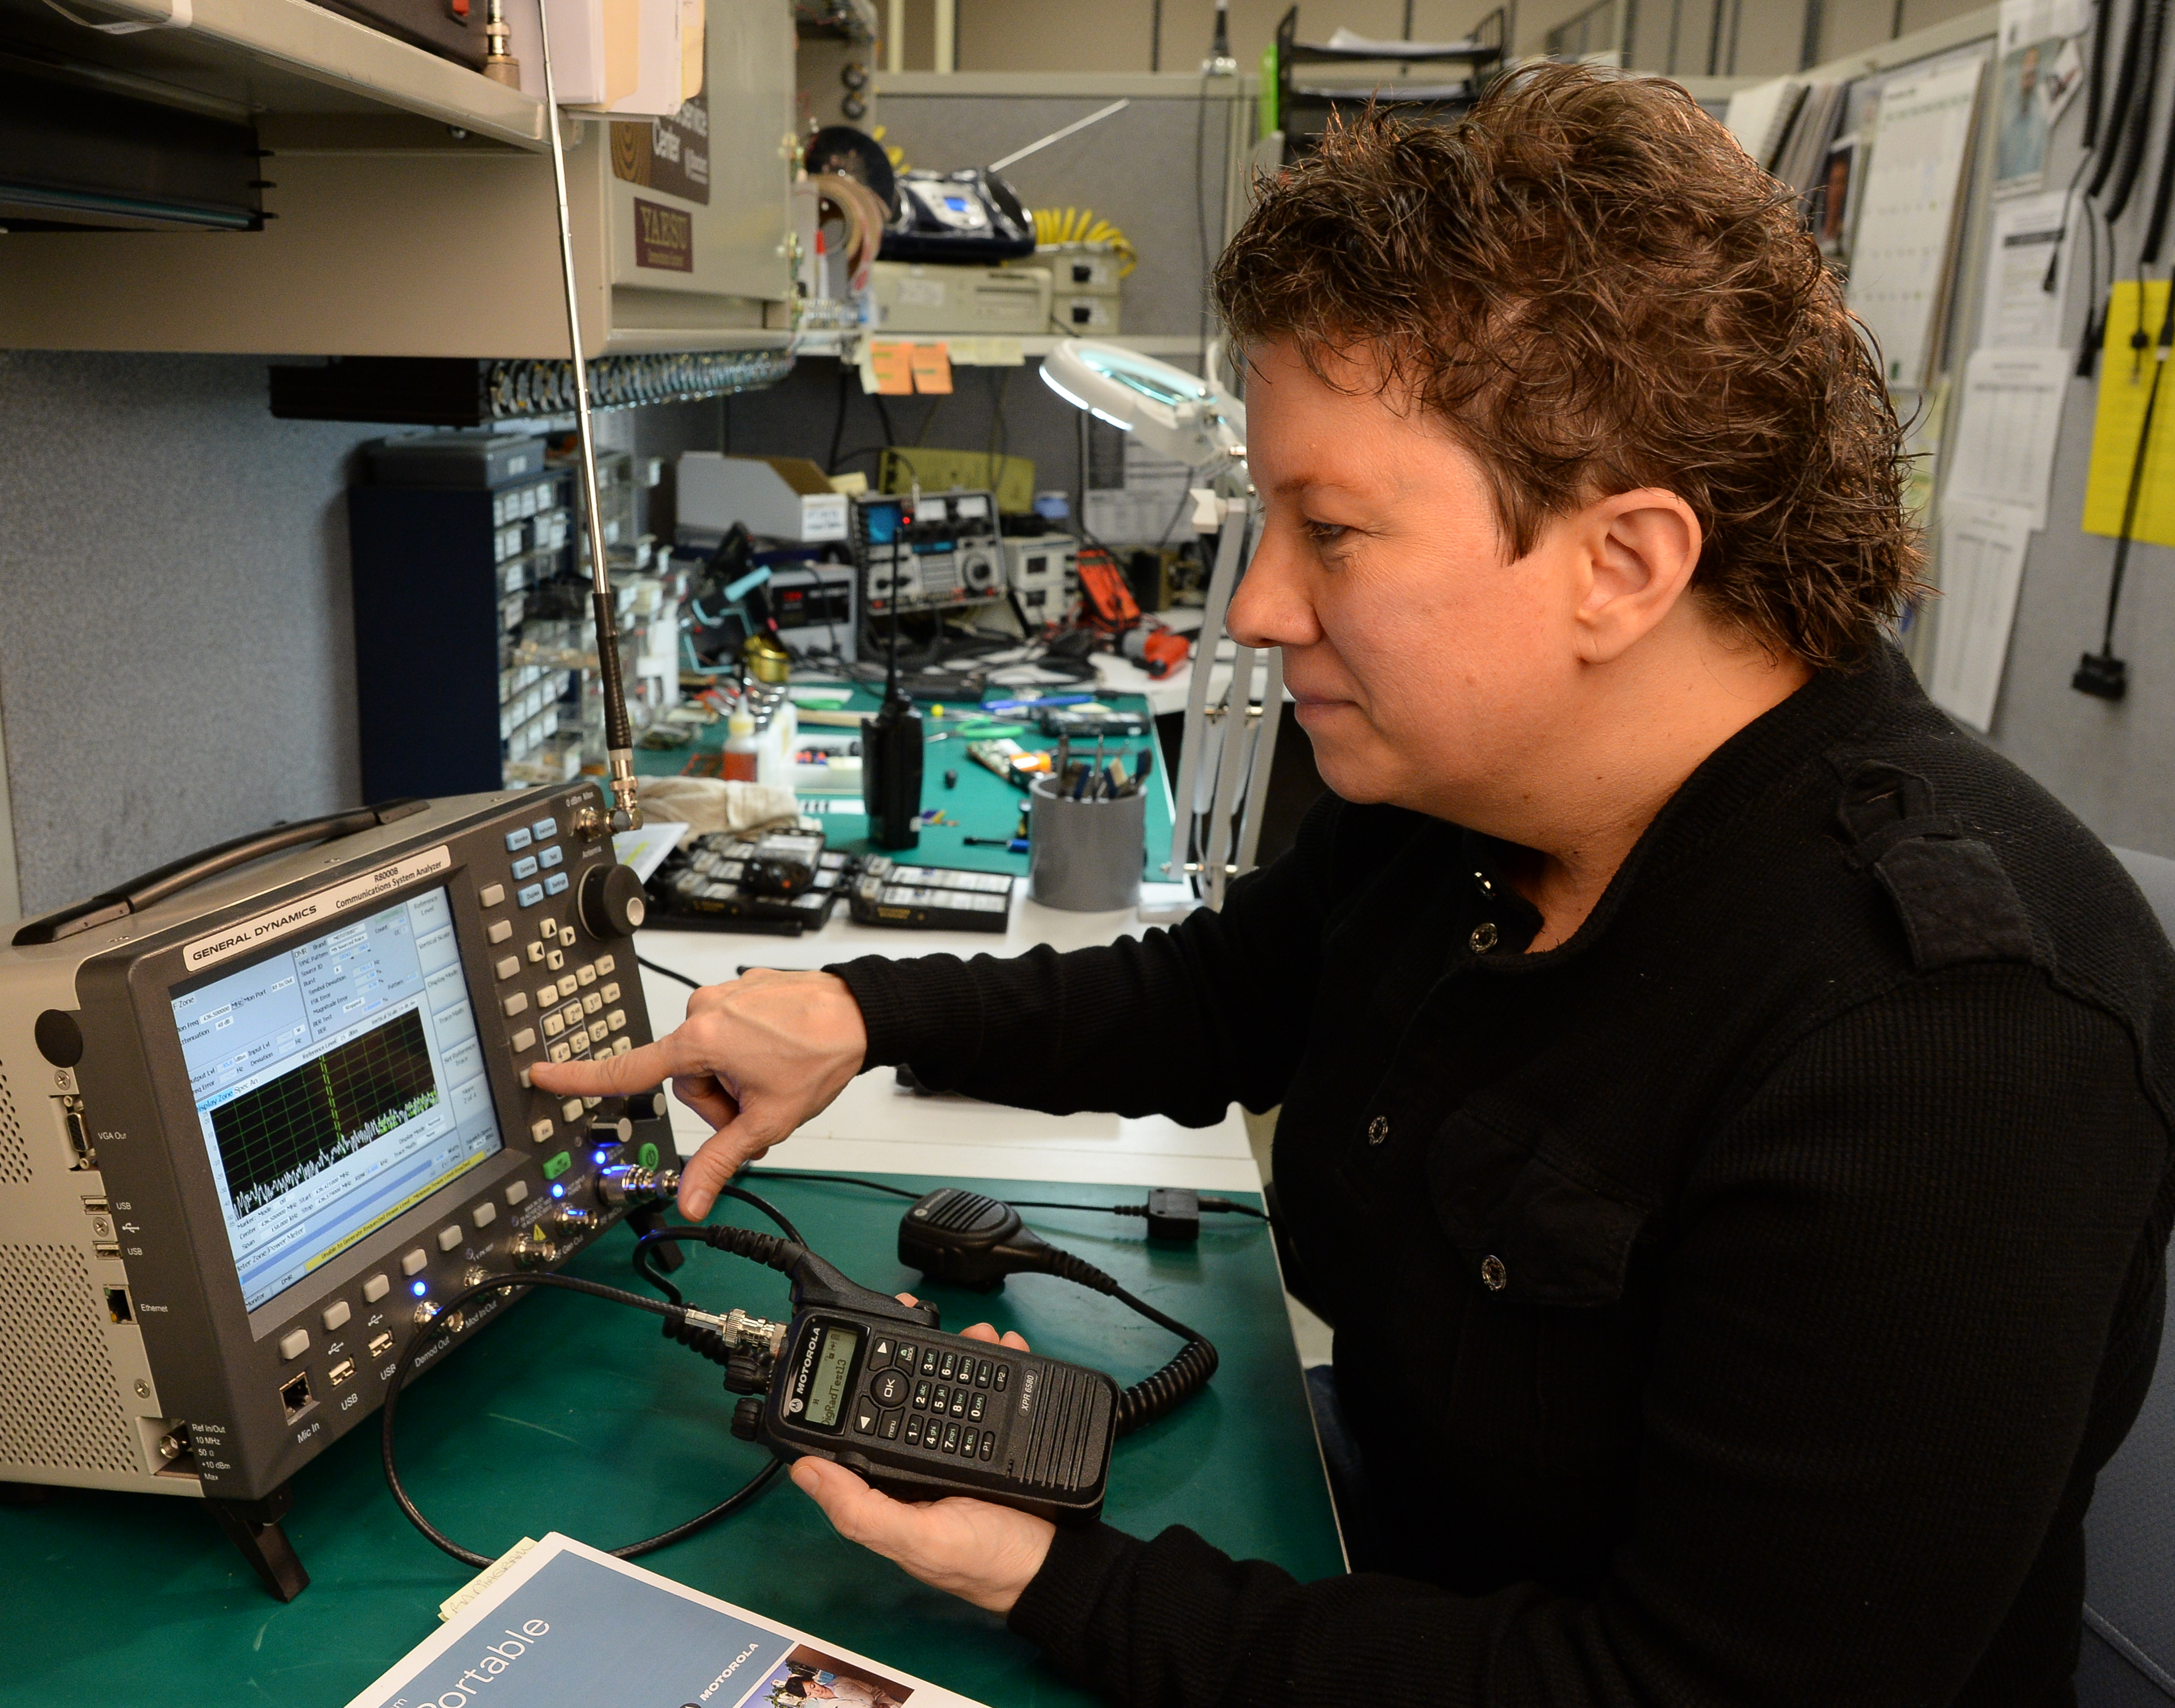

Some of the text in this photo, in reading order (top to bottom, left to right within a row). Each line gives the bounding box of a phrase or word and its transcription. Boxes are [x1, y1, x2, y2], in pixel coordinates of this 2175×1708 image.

[373, 866, 399, 883] R8000B
[335, 859, 442, 909] Communications System Analyzer
[420, 904, 434, 916] Level
[192, 905, 318, 961] GENERAL DYNAMICS
[313, 940, 327, 950] Brand
[418, 936, 437, 949] Vertical
[294, 947, 307, 958] DMR
[311, 949, 328, 962] Pattern
[301, 966, 316, 977] Source
[427, 968, 458, 988] Display Mode
[303, 977, 315, 987] Burst
[308, 974, 346, 996] Symbol Deviation
[178, 996, 194, 1008] Zone
[244, 989, 266, 1003] Mon Port
[319, 992, 331, 1002] Error
[231, 1000, 242, 1009] MHz
[313, 994, 348, 1016] Magnitude Error
[589, 999, 595, 1011] 3
[313, 1013, 332, 1027] BER Test
[439, 1006, 464, 1024] Trace Math
[569, 1009, 577, 1022] 2
[187, 1019, 199, 1029] Freq
[318, 1026, 327, 1035] BER
[551, 1020, 556, 1032] 1
[595, 1027, 601, 1039] 6
[248, 1044, 263, 1057] Input
[302, 1038, 337, 1060] Reference Level
[576, 1038, 582, 1050] 5
[250, 1051, 273, 1066] Deviation
[455, 1055, 468, 1067] Trace
[557, 1049, 562, 1060] 4
[207, 1067, 215, 1076] Lvl
[202, 1079, 215, 1090] Error
[217, 1076, 258, 1101] Zone Spec An
[339, 1171, 349, 1180] MHz
[342, 1179, 351, 1190] MHz
[299, 1192, 311, 1204] Start
[116, 1202, 131, 1211] USB
[287, 1201, 297, 1212] MHz
[301, 1203, 313, 1215] Stop
[237, 1205, 272, 1230] Marker: Mode
[289, 1211, 298, 1222] kHz
[239, 1226, 256, 1240] Center
[321, 1245, 337, 1260] Unable
[336, 1241, 343, 1250] to
[343, 1229, 363, 1246] Generate
[362, 1213, 385, 1234] Requested
[385, 1205, 399, 1218] Power
[398, 1197, 410, 1209] Level
[241, 1237, 255, 1251] Span
[252, 1225, 305, 1263] Zone Power Meter
[562, 1233, 583, 1253] Gen Out
[281, 1273, 293, 1286] DMR
[141, 1304, 168, 1312] Ethernet
[464, 1300, 498, 1329] Mod In/Out
[414, 1335, 451, 1367] Demod Out
[904, 1345, 914, 1361] back
[796, 1326, 821, 1394] MOTOROLA
[380, 1363, 397, 1381] USB
[923, 1363, 934, 1371] 3
[941, 1367, 951, 1376] 6
[959, 1372, 969, 1380] 9
[997, 1370, 1006, 1382] P2
[883, 1377, 895, 1398] OK
[1021, 1374, 1034, 1411] XPR 6580
[340, 1393, 359, 1411] USB
[915, 1395, 926, 1404] 2
[934, 1400, 944, 1409] 5
[952, 1392, 964, 1412] 8 tuv
[970, 1409, 981, 1417] 0
[192, 1423, 226, 1434] Ref In/Out
[297, 1422, 320, 1444] Mic In
[887, 1419, 897, 1438] menu
[926, 1425, 938, 1444] 4 ghi
[205, 1437, 221, 1446] MHz
[944, 1427, 956, 1449] 7 pqrs
[982, 1441, 991, 1451] P1
[415, 1618, 550, 1708] ortable
[698, 1642, 759, 1702] MOTOROLA
